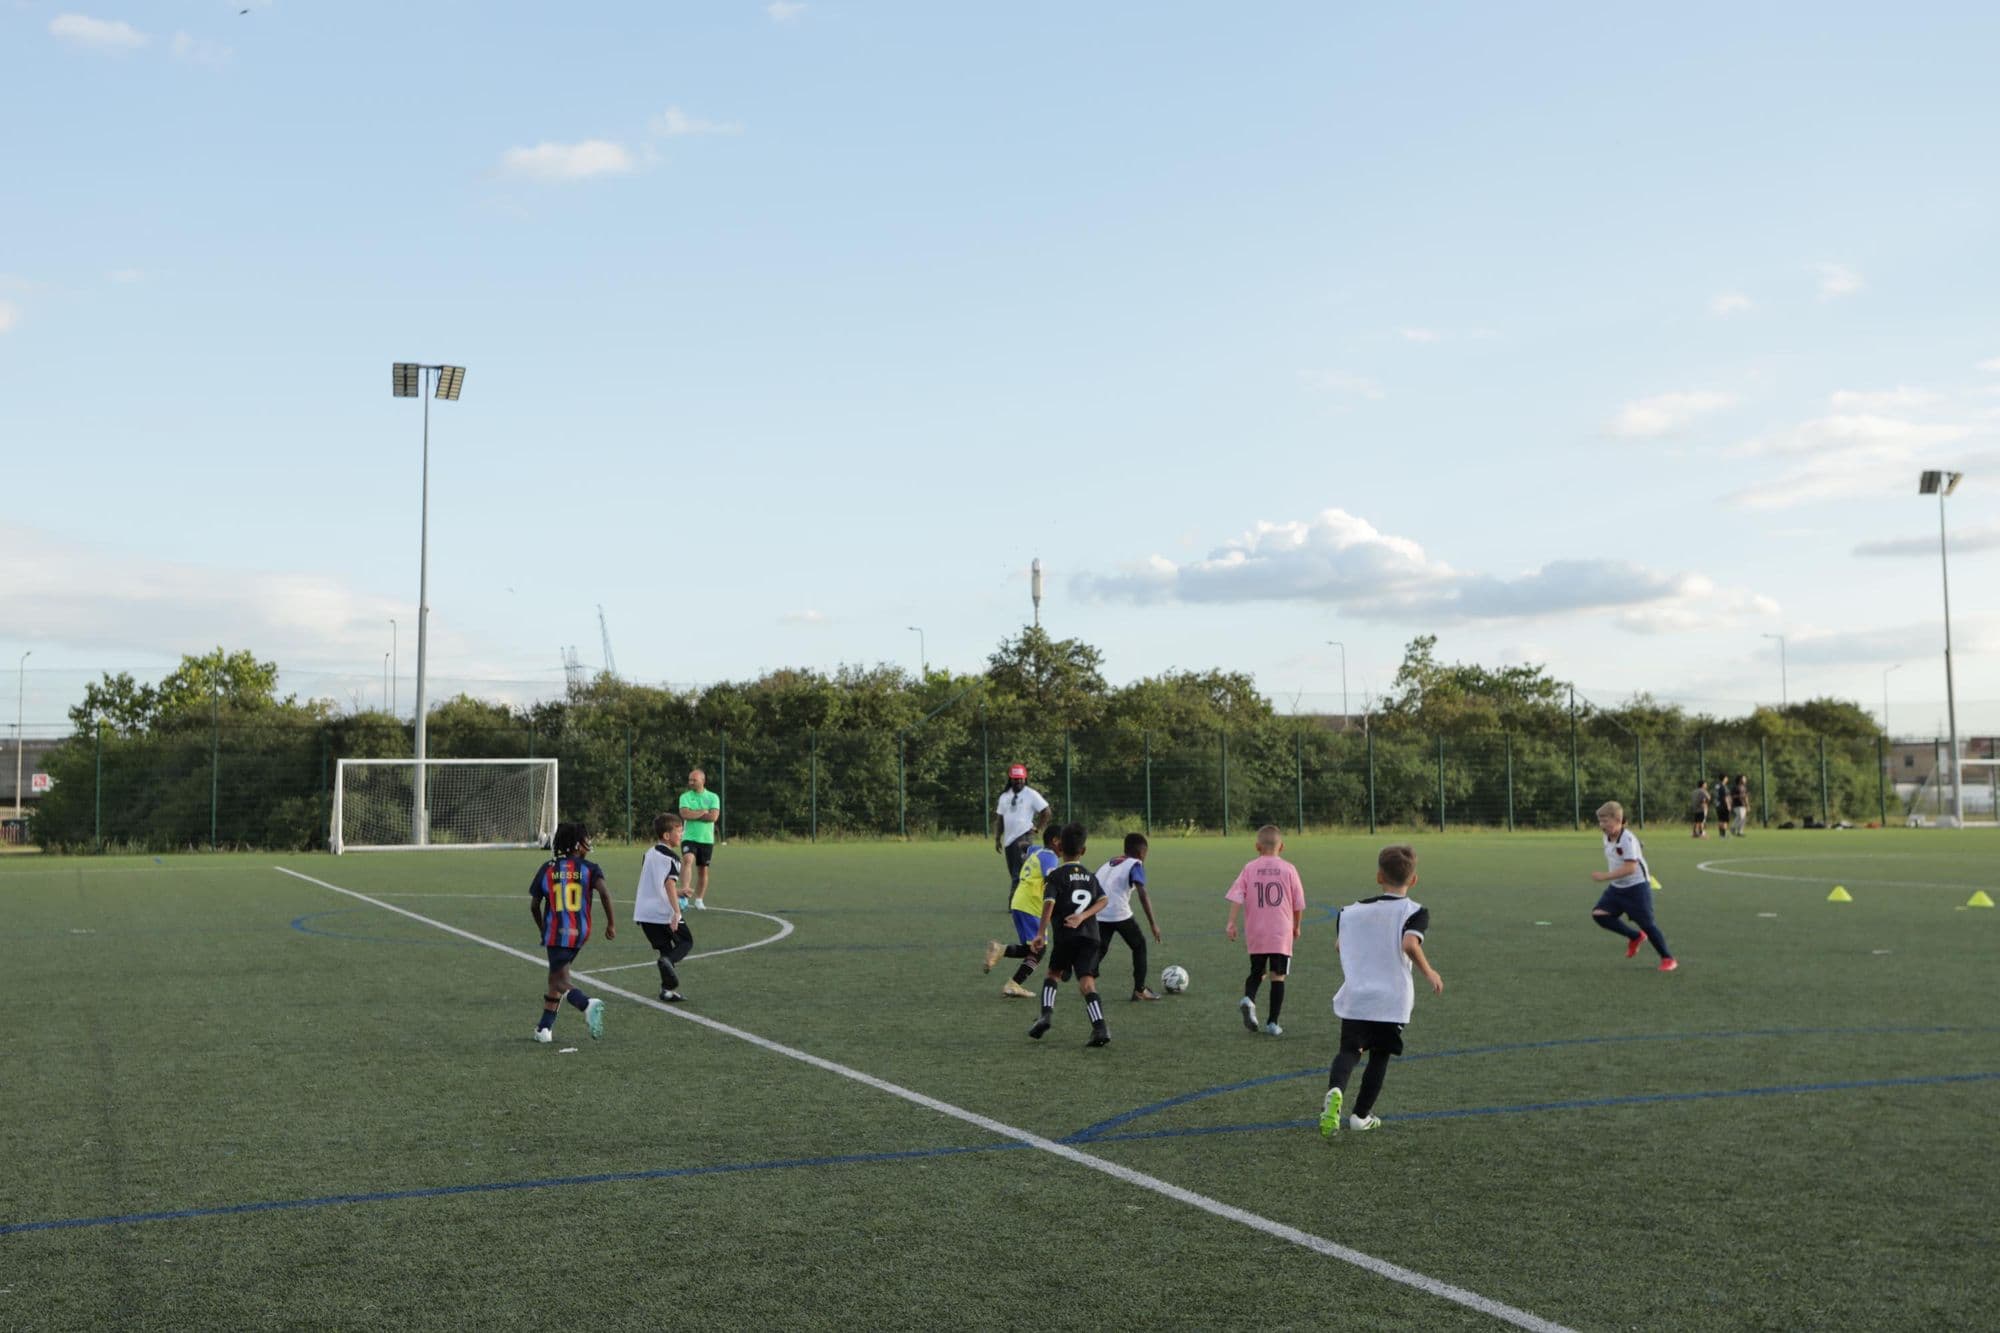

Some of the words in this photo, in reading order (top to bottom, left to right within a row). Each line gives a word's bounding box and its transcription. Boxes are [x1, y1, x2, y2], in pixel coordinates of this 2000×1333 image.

[551, 871, 583, 880] MESSI
[553, 882, 583, 912] 10
[1071, 888, 1092, 915] 9
[1254, 881, 1283, 908] 10
